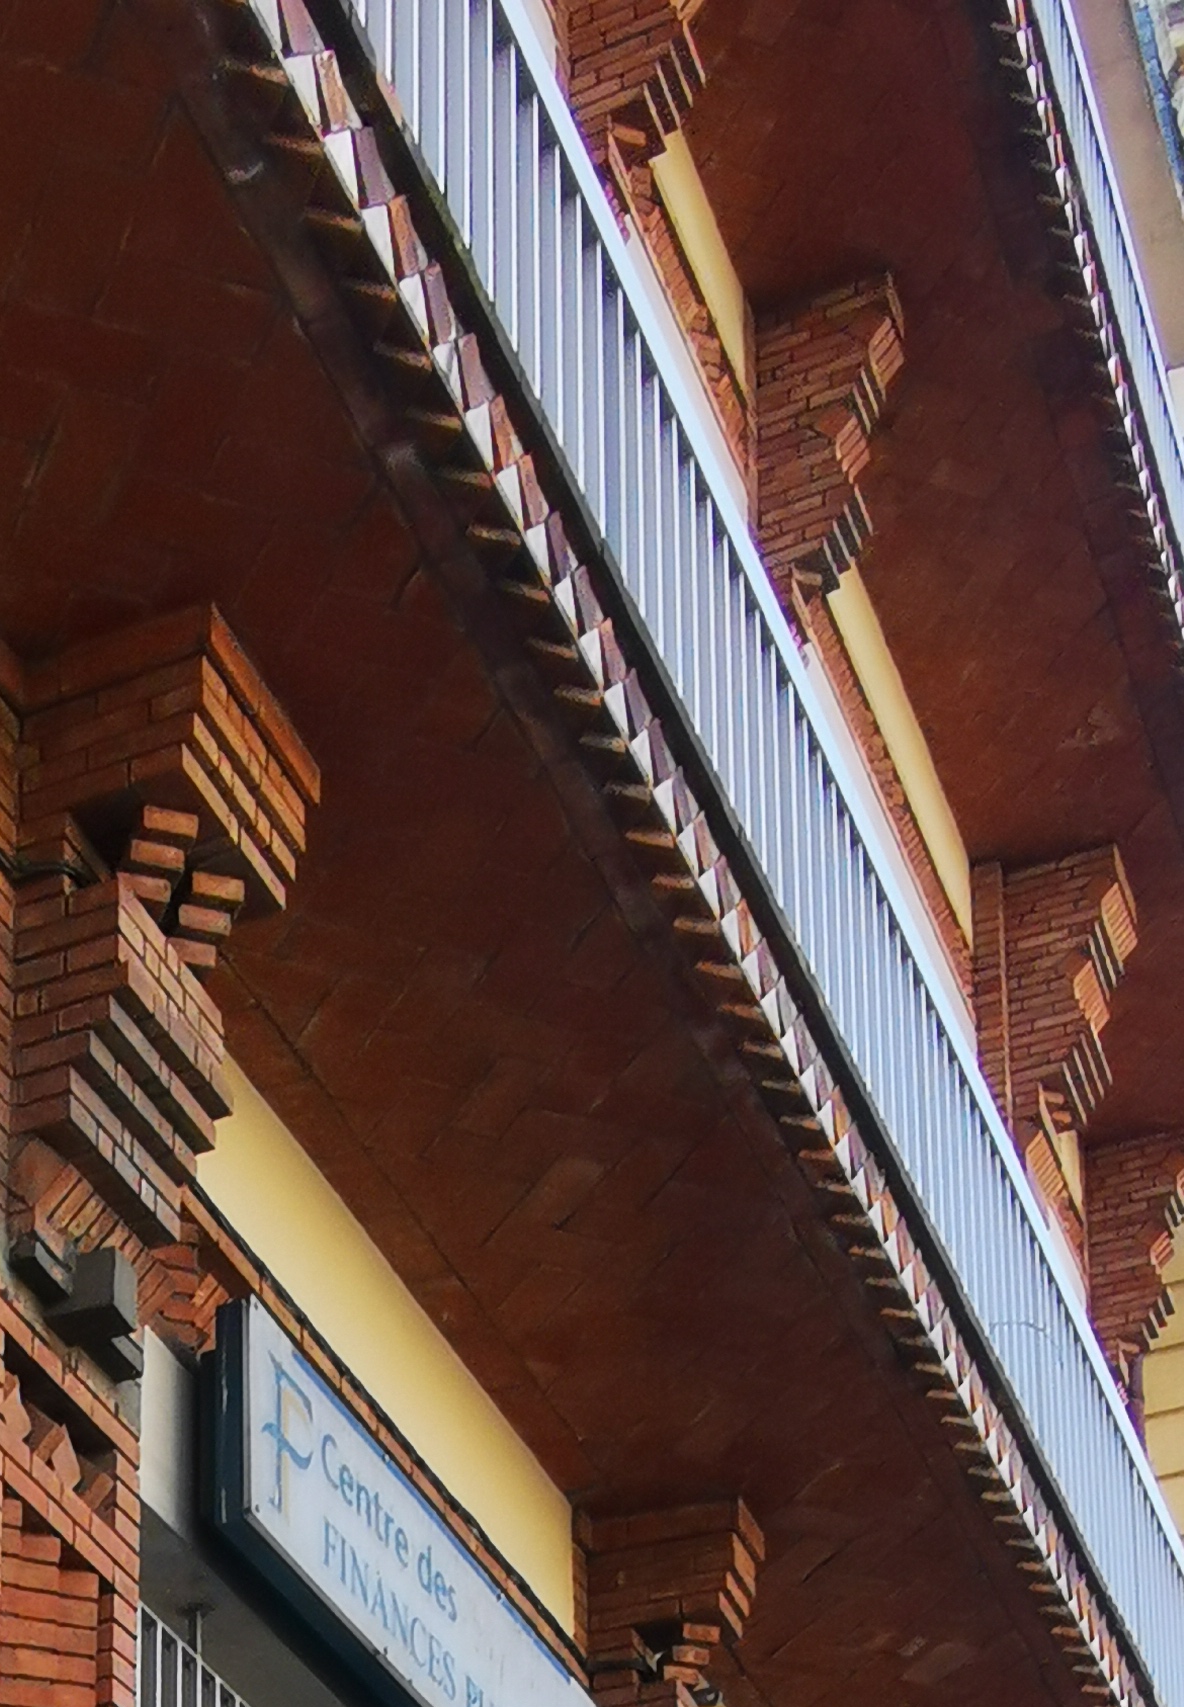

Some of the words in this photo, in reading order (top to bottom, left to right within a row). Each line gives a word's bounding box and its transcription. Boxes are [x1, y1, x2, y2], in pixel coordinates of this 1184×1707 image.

[321, 1433, 409, 1569] Centre
[417, 1544, 458, 1624] des
[322, 1516, 457, 1701] FINANCES
